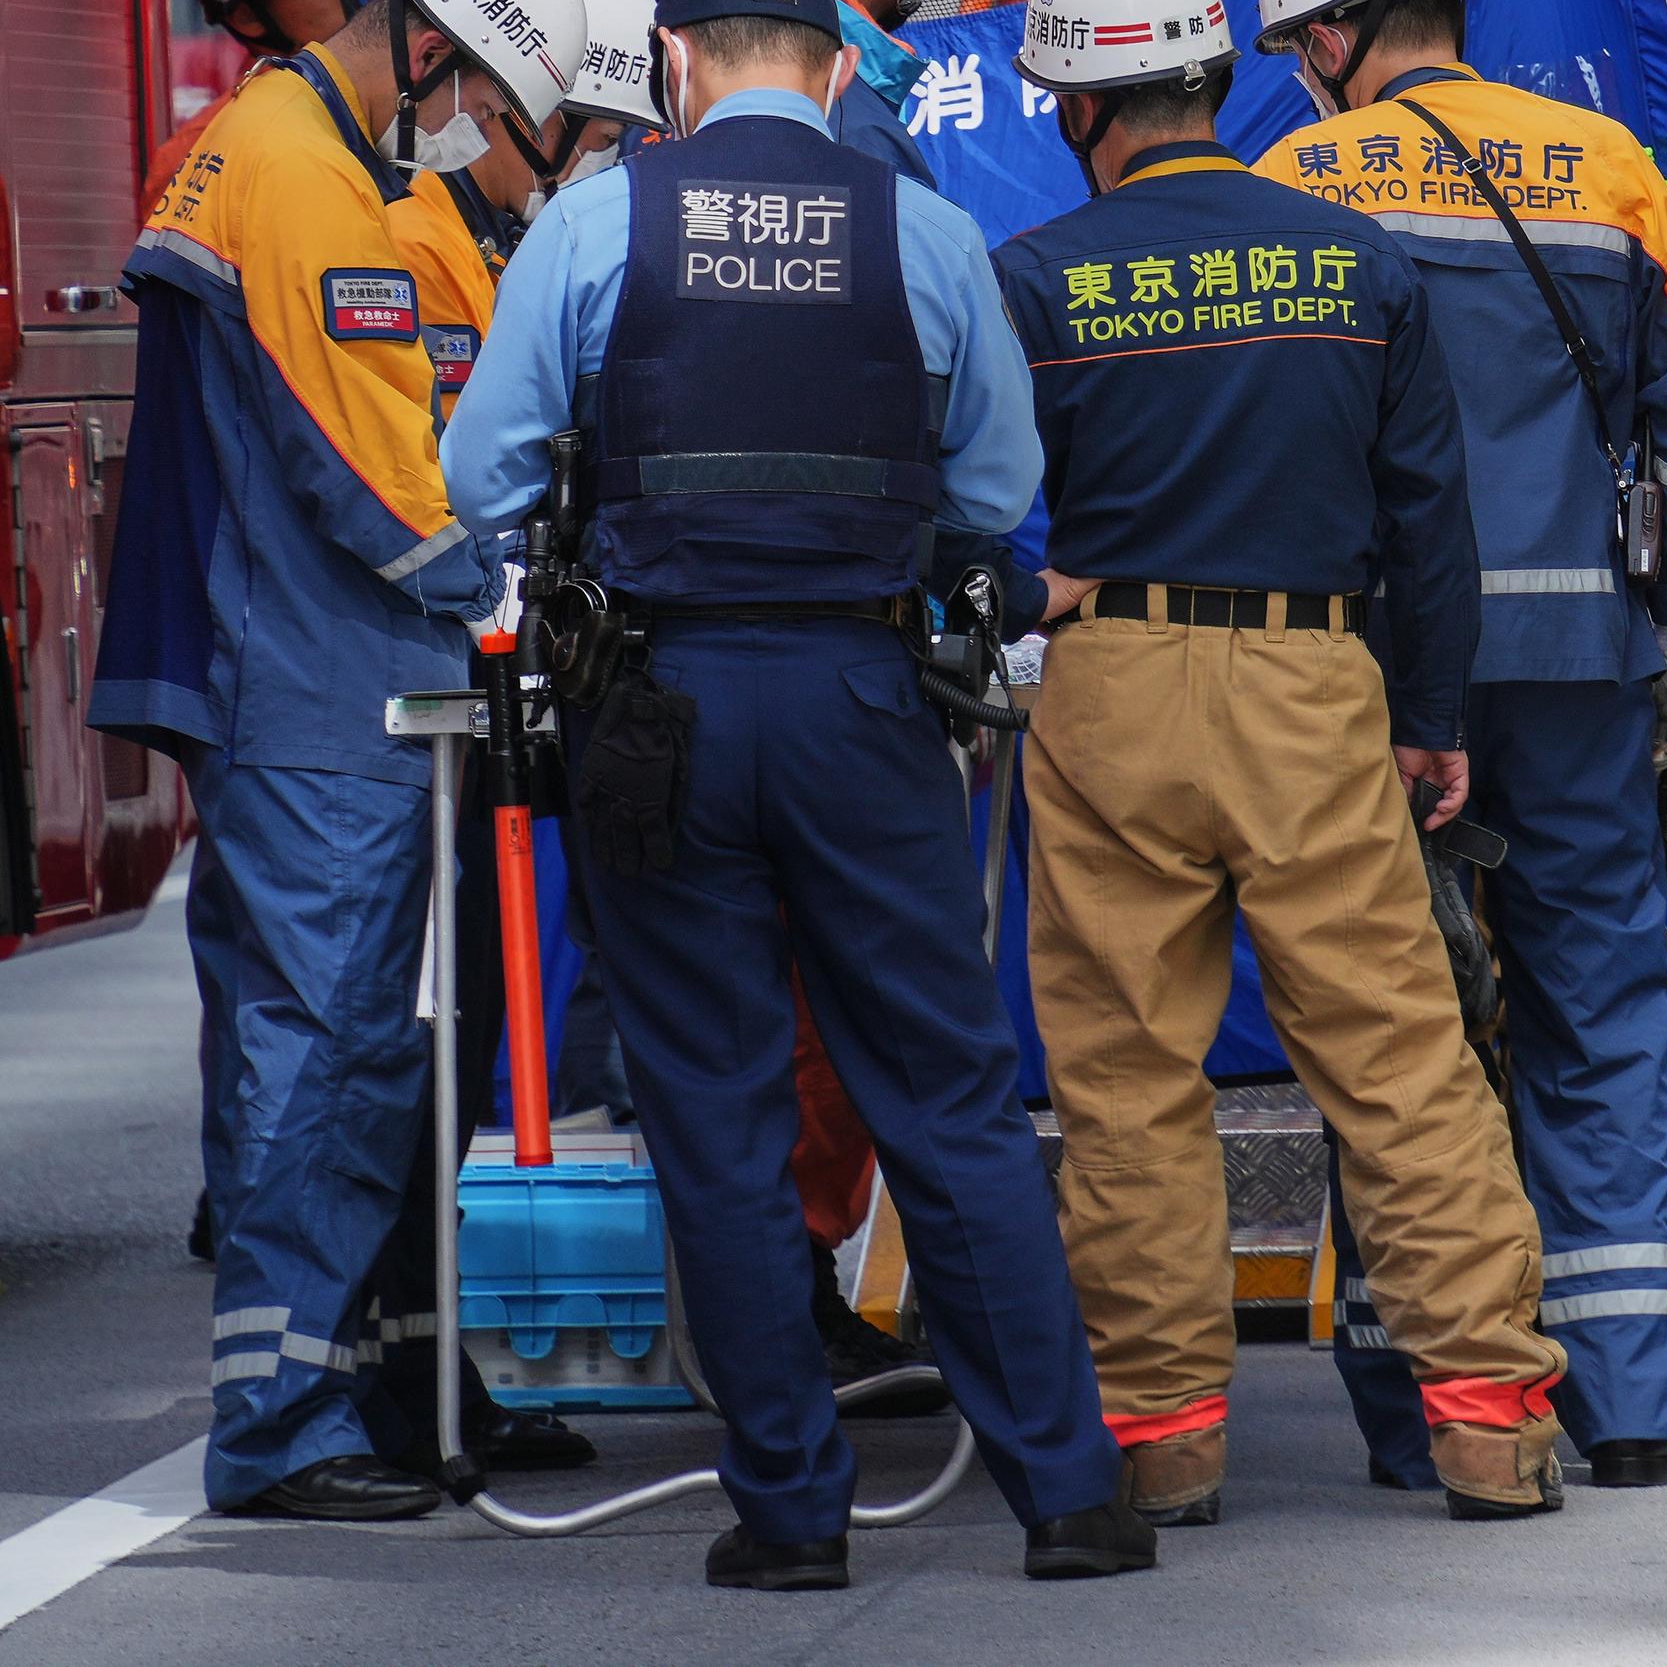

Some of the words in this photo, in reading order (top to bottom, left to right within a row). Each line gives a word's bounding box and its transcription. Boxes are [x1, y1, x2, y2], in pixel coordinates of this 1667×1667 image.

[1163, 15, 1205, 40] 警防
[580, 40, 648, 86] 消防庁
[1294, 134, 1584, 183] 東京消防庁
[681, 189, 846, 245] 警視庁
[1420, 181, 1488, 207] FIRE
[1502, 185, 1588, 211] DEPT.
[337, 287, 393, 300] 救急機動部隊
[687, 252, 841, 292] POLICE
[1062, 244, 1358, 311] 東京消防庁
[353, 310, 400, 322] 救急救命士
[1068, 309, 1185, 345] TOKYO
[1193, 300, 1264, 332] FIRE
[1272, 297, 1358, 327] DEPT.
